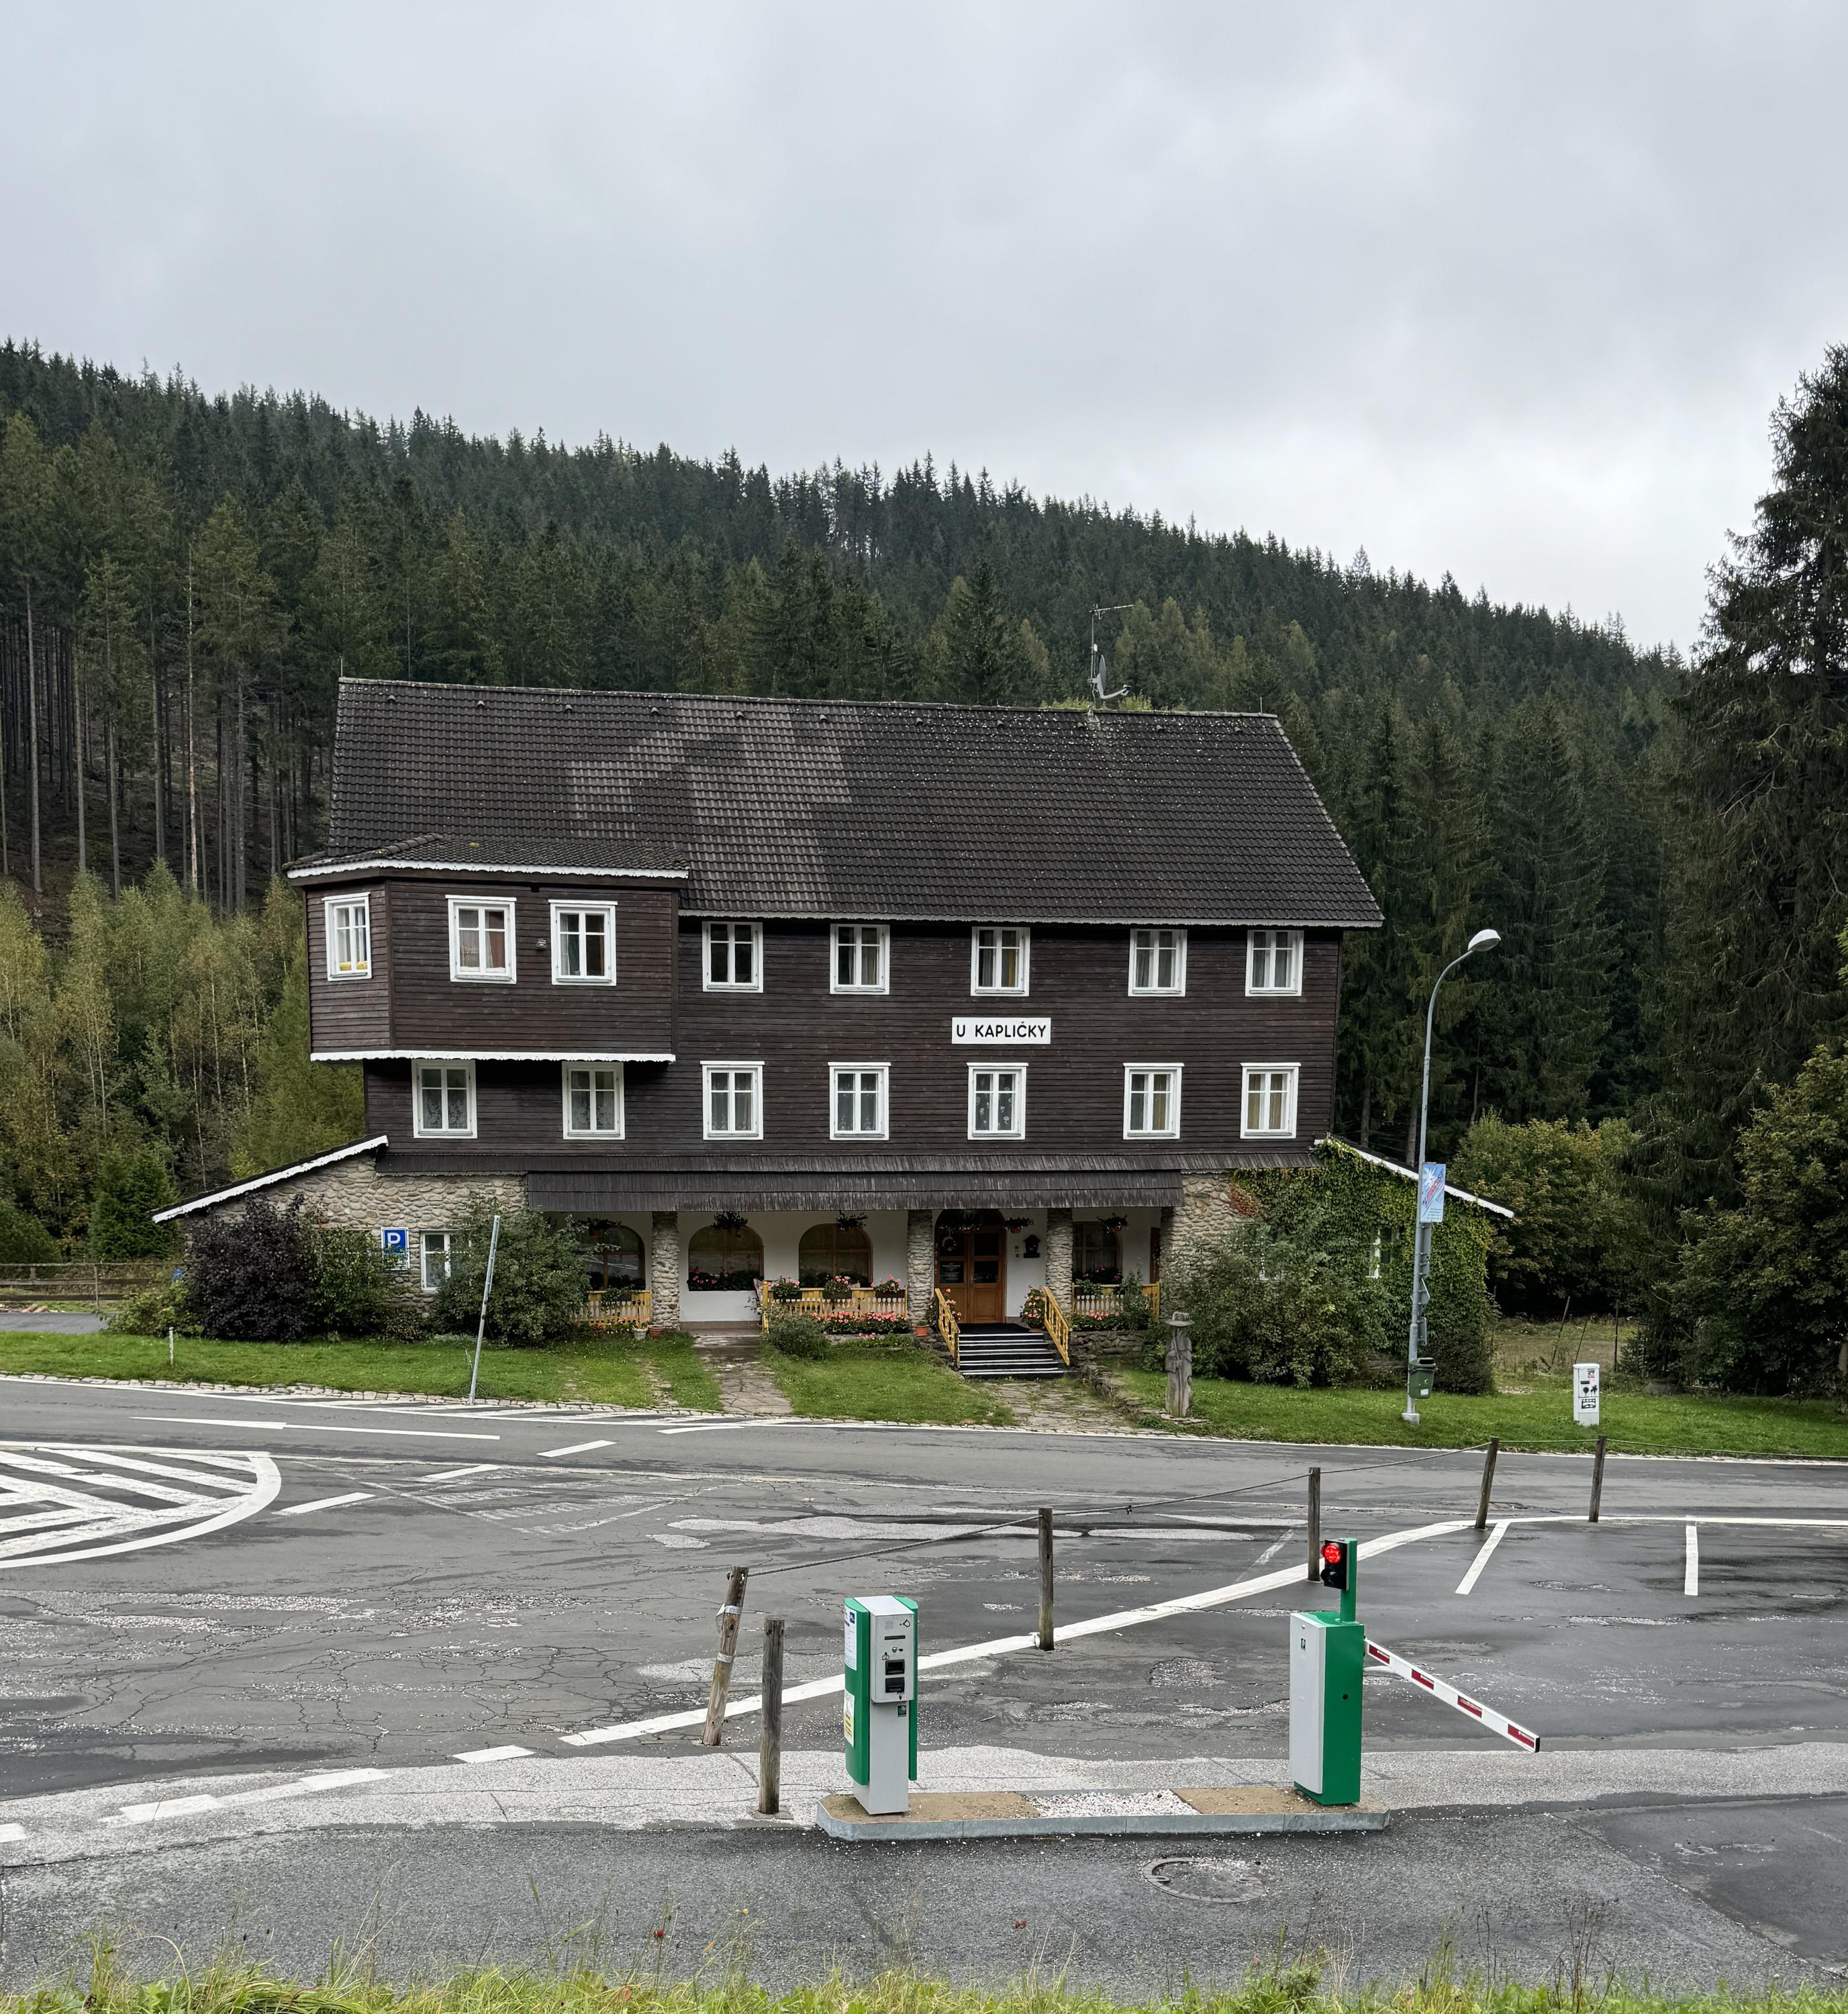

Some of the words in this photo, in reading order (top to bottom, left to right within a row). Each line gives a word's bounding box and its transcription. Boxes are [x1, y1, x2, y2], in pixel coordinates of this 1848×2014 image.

[957, 1024, 965, 1037] U
[975, 1021, 1046, 1037] KAPLIČKY
[387, 1233, 401, 1247] P
